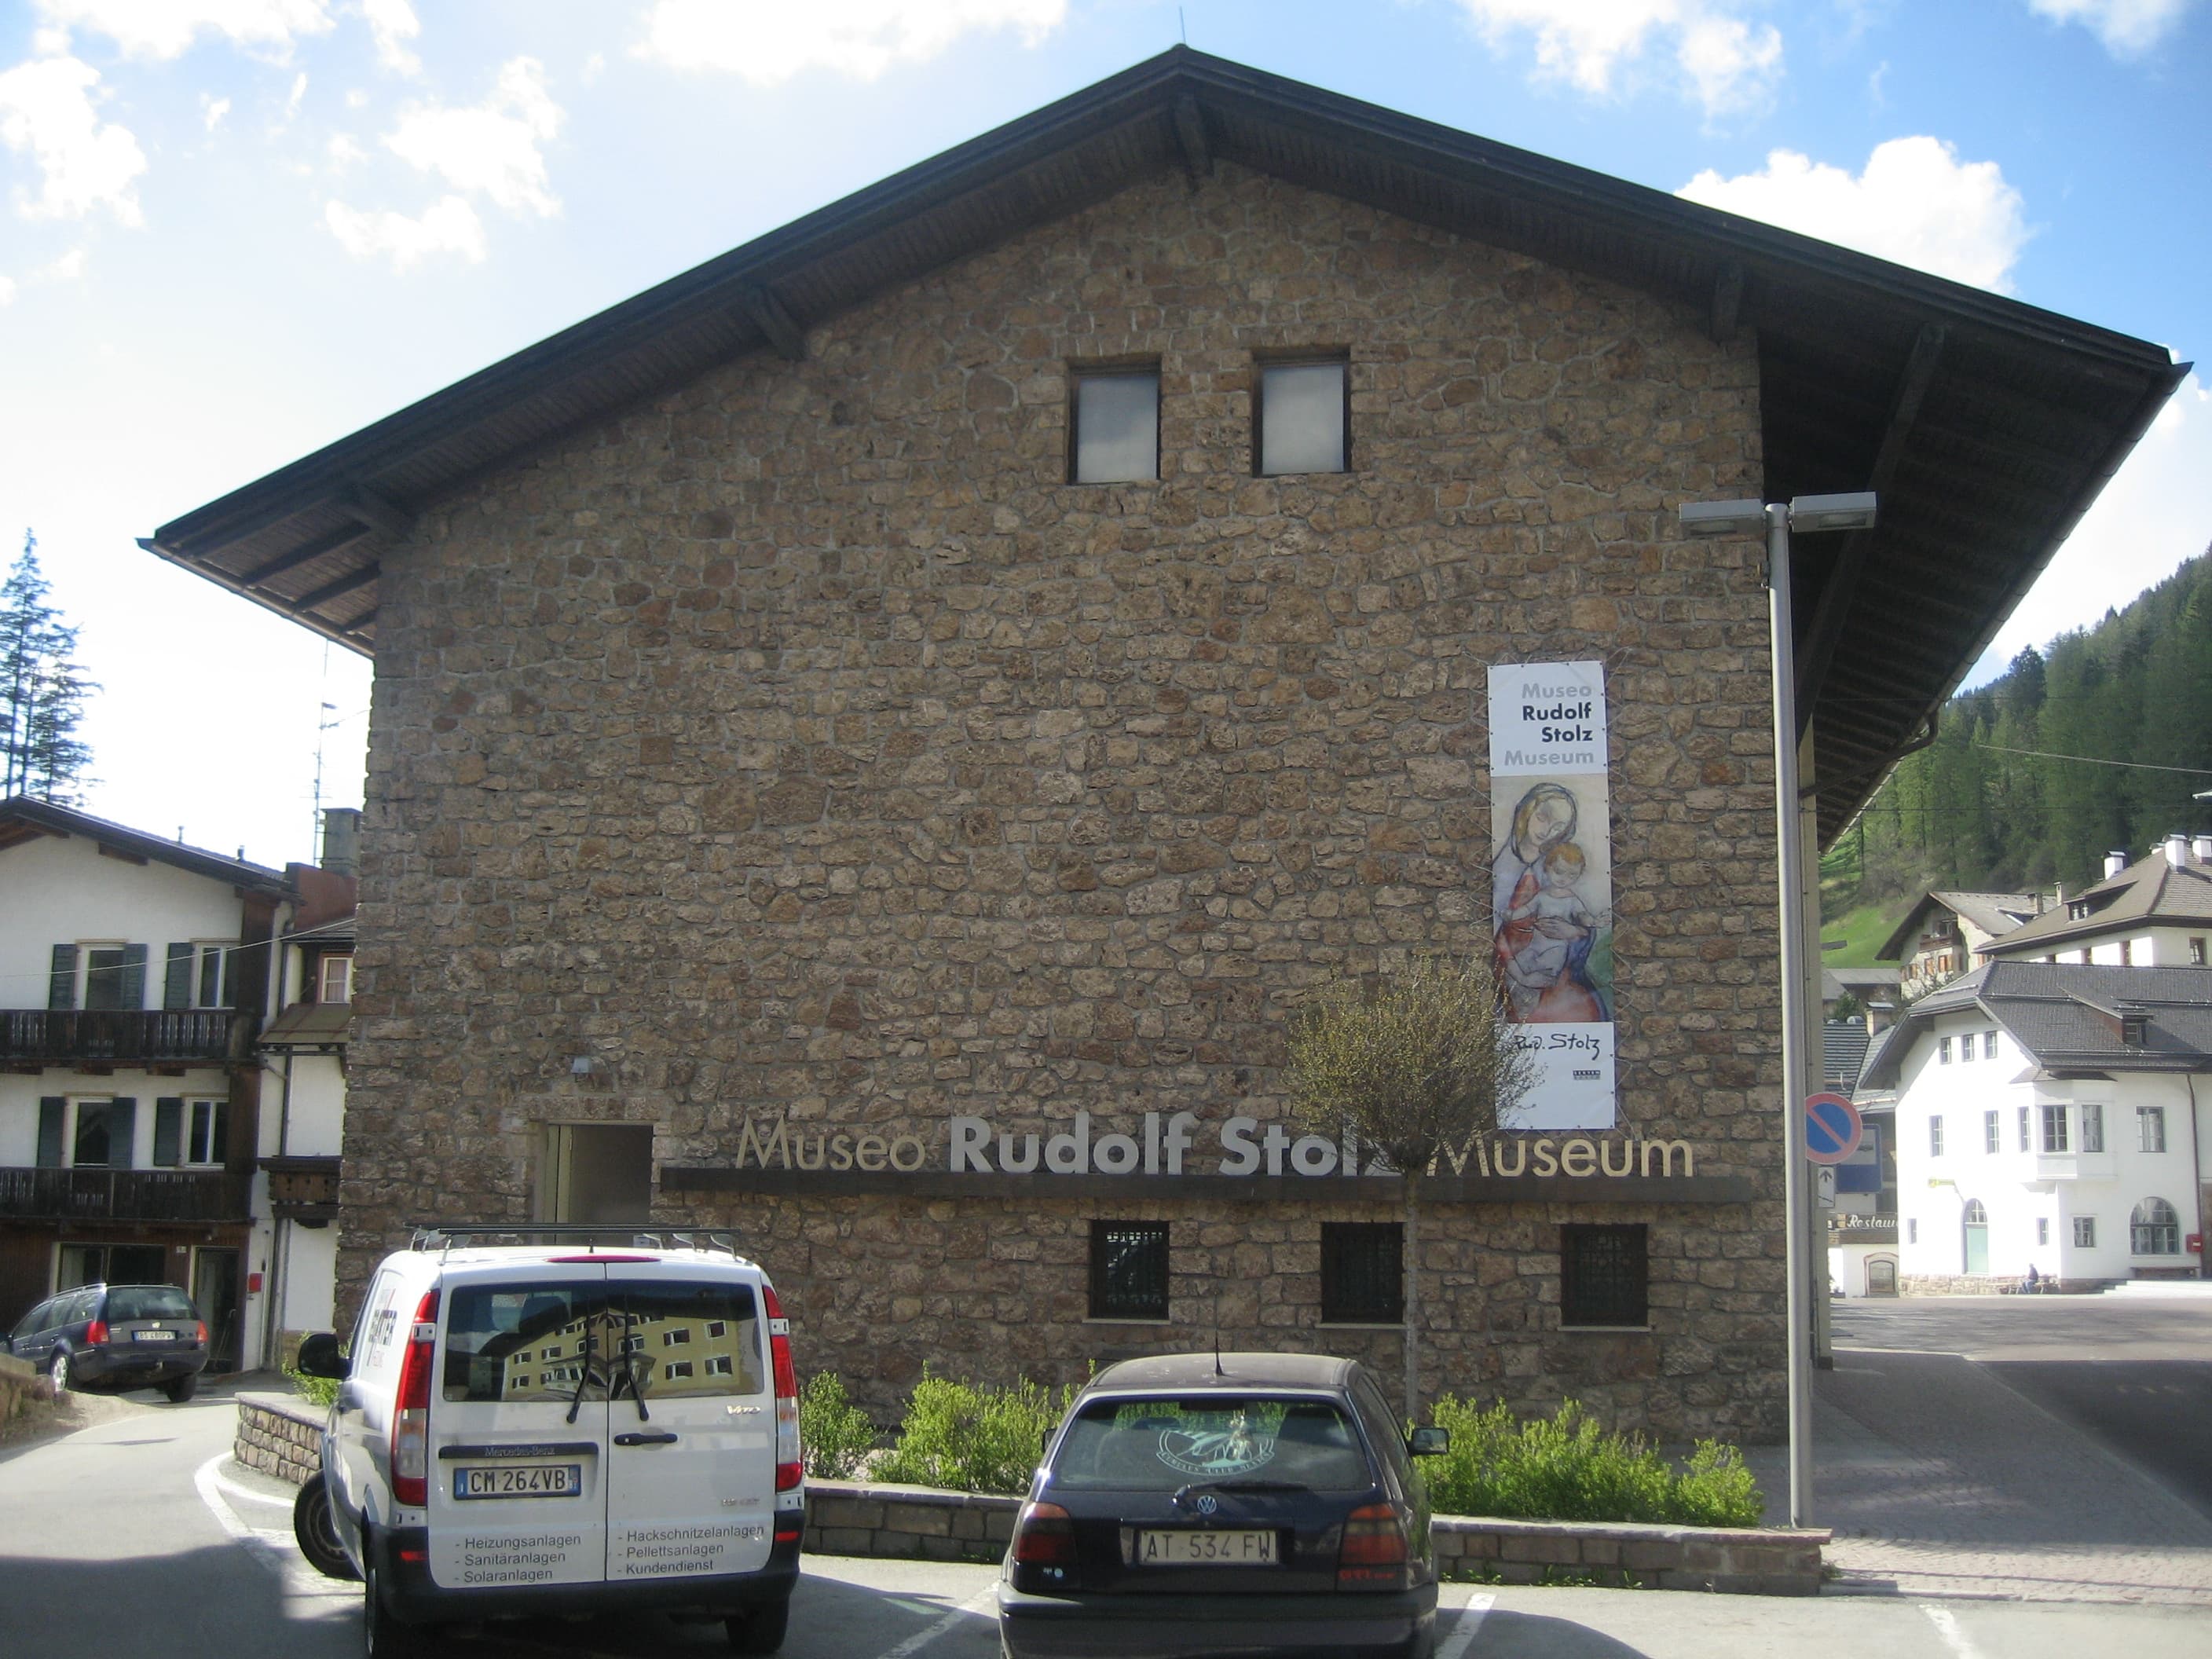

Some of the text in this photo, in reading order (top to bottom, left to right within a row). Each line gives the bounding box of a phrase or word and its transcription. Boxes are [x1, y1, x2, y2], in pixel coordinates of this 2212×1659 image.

[1522, 683, 1591, 698] Museo
[1522, 701, 1591, 721] Rudolf
[1541, 724, 1593, 742] Stolz
[1503, 749, 1594, 766] Museum
[734, 1113, 926, 1171] Museo
[950, 1111, 1196, 1174] Rudolf
[1426, 1125, 1693, 1177] Museum
[485, 1447, 555, 1457] Mercedes-Benz
[471, 1471, 495, 1492] CM
[503, 1469, 566, 1491] 264VB
[465, 1534, 581, 1550] Heizungsanlagen
[627, 1525, 764, 1542] Hackschnitzelanlagen
[1147, 1532, 1270, 1558] AT 534 FW
[464, 1551, 566, 1567] Sanitäranlagen
[626, 1559, 714, 1575] Kundendienst
[464, 1569, 553, 1584] Solaranlagen
